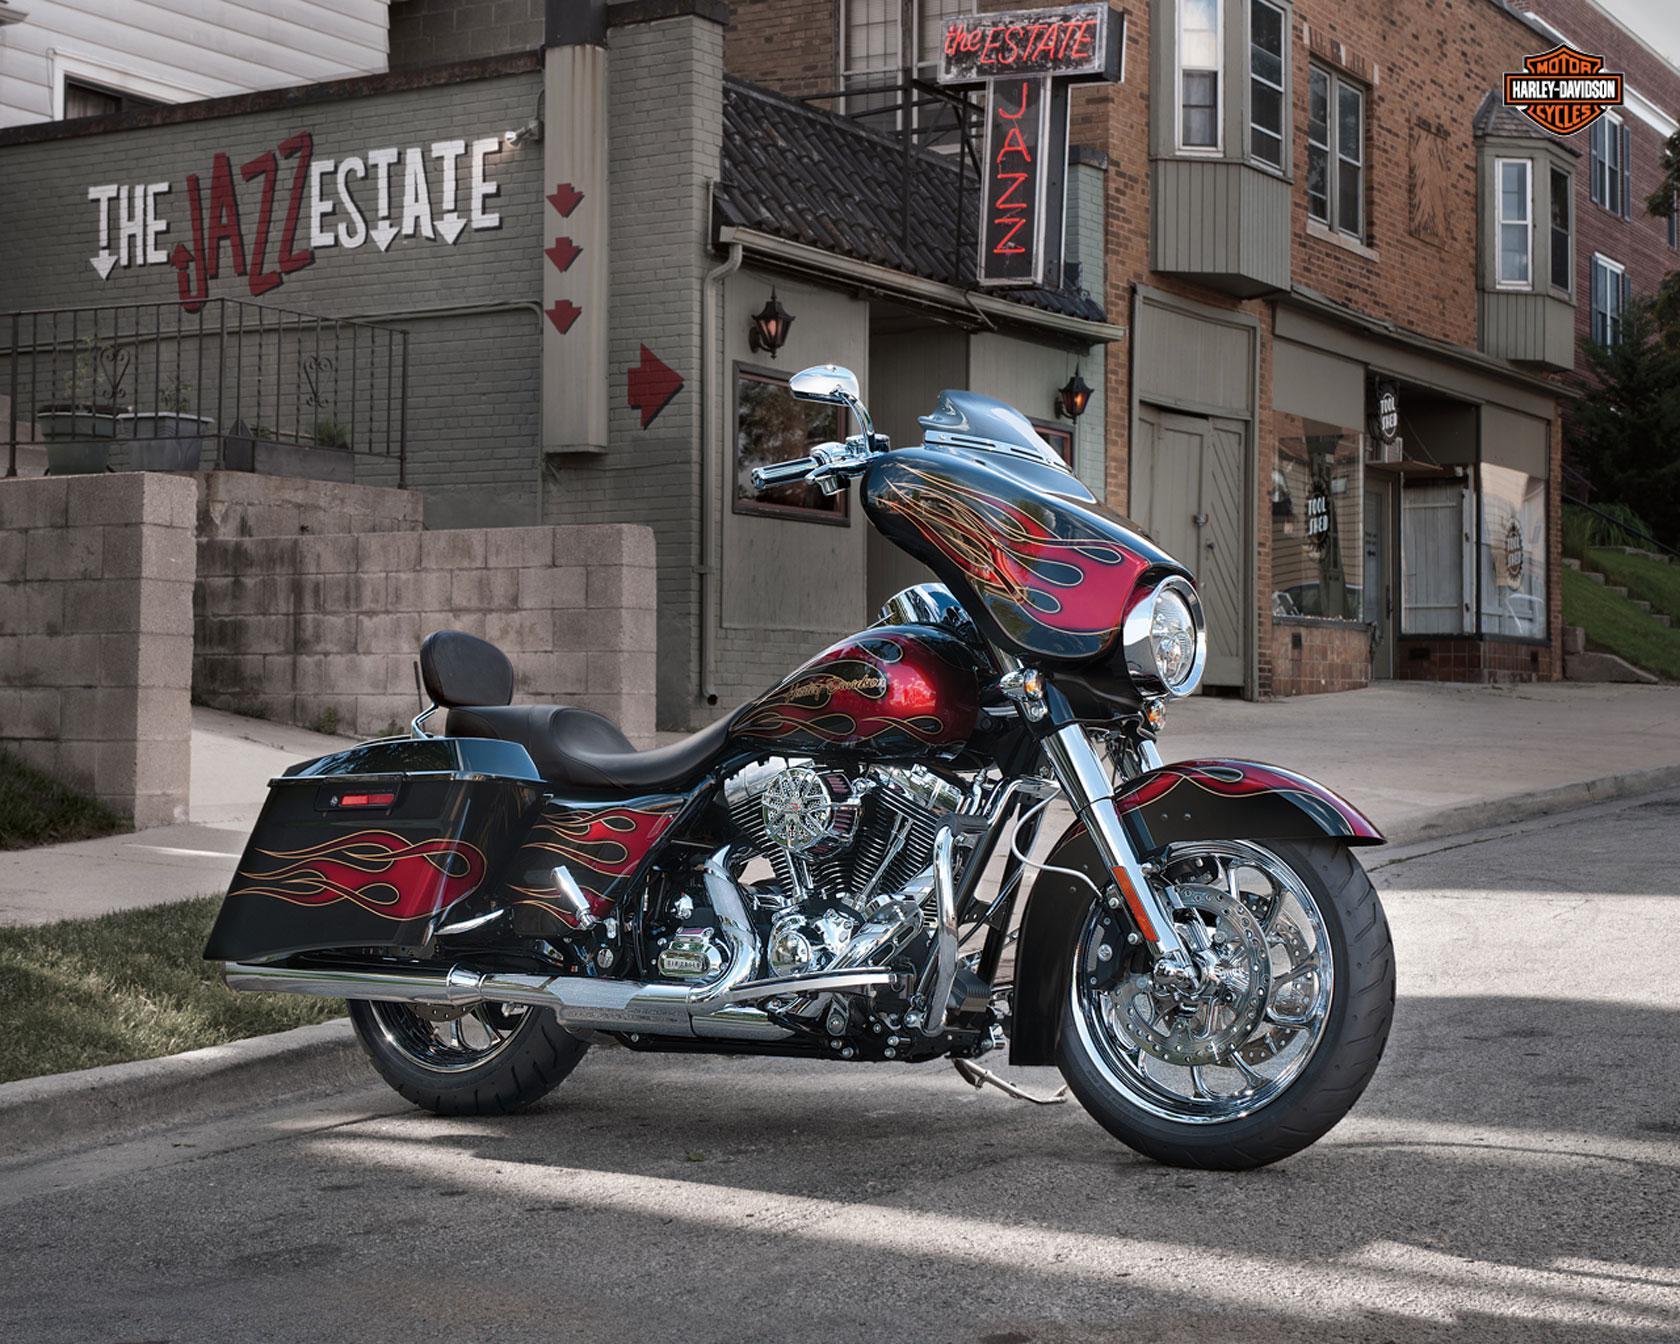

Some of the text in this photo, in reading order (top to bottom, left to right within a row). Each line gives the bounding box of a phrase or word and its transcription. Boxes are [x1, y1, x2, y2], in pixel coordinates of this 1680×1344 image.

[944, 20, 1098, 65] the ESTATE
[993, 82, 1032, 253] JAZZ
[87, 131, 501, 313] THE JAZZ ESTATE
[1380, 397, 1395, 414] TOOL
[1382, 412, 1398, 430] SHED
[1308, 496, 1326, 516] TOOL
[1308, 515, 1329, 536] SHED
